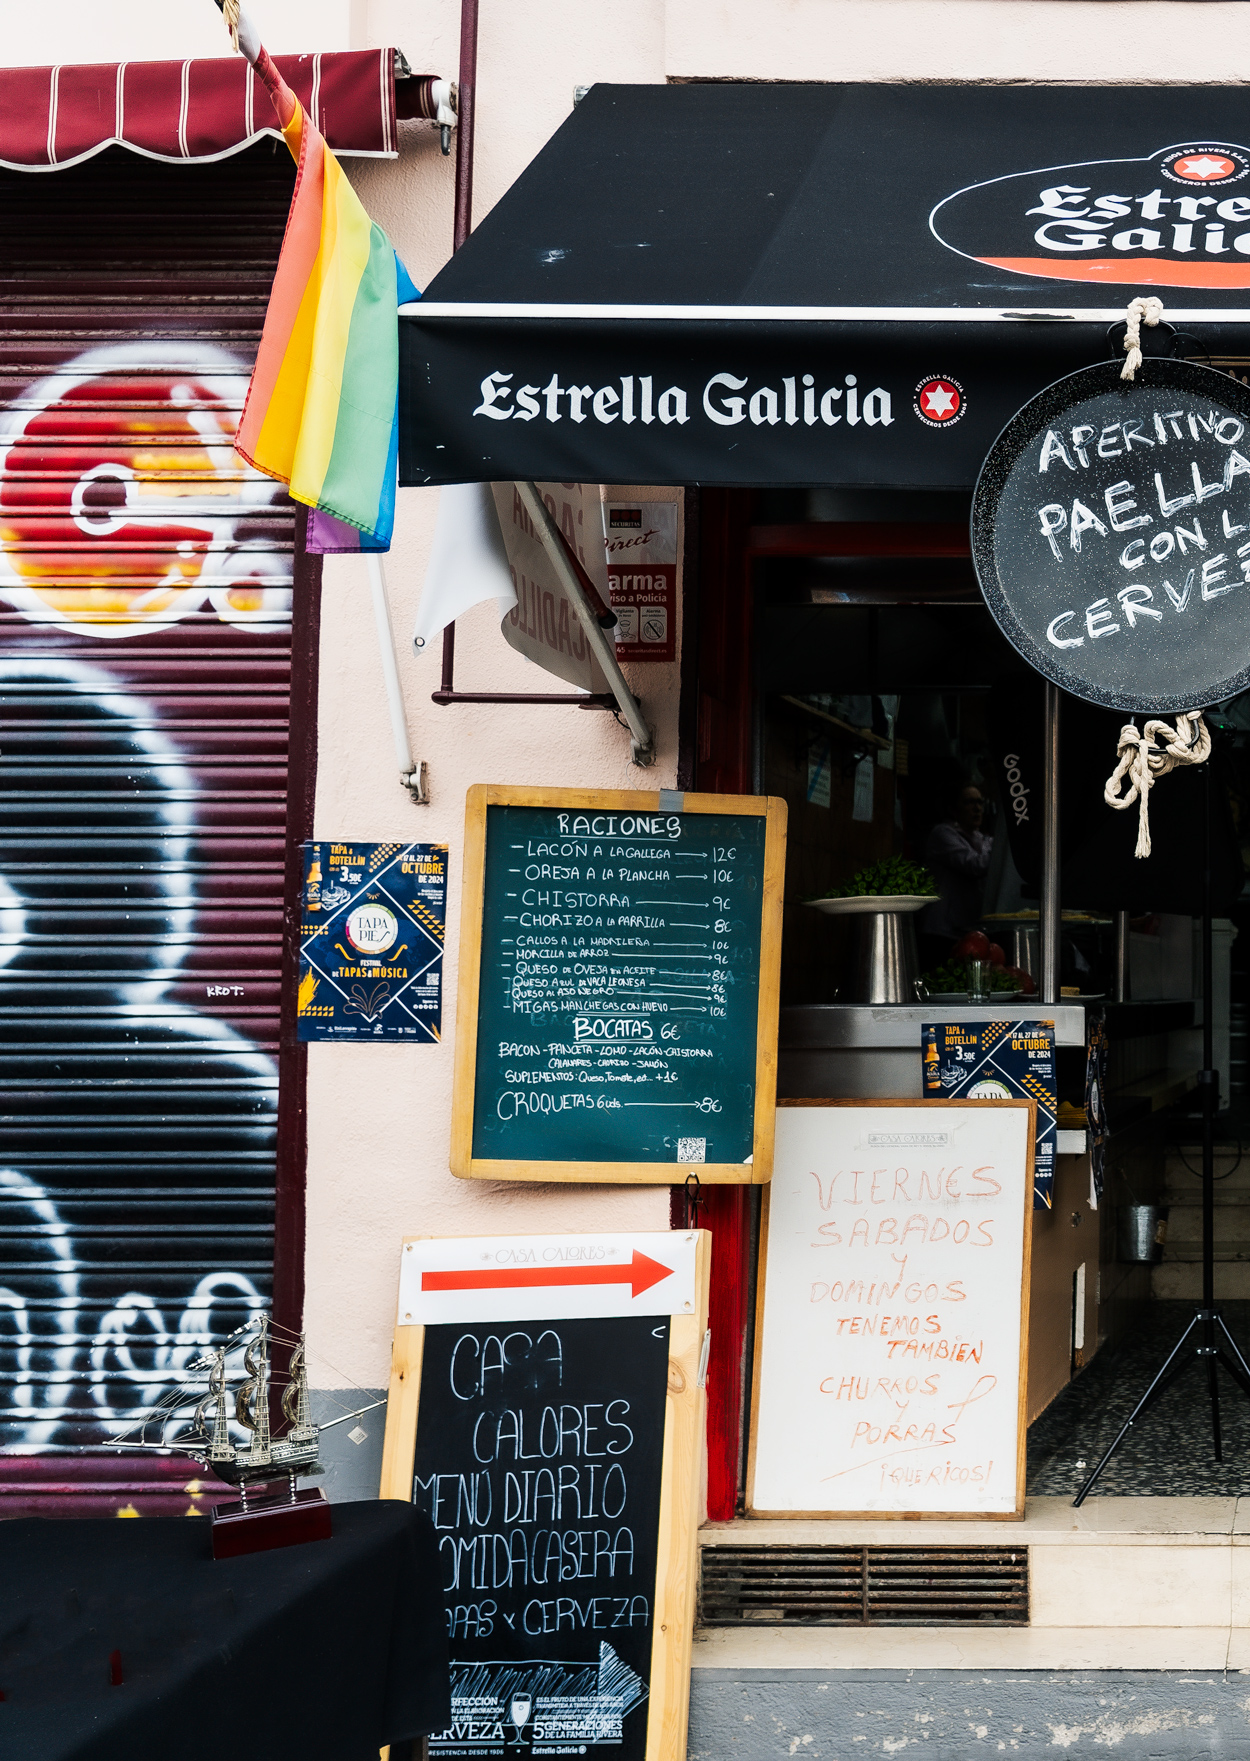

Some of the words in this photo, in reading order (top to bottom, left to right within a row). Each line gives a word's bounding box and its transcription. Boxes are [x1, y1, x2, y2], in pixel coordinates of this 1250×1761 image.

[915, 374, 941, 392] ESTRELLA
[942, 374, 964, 393] GALICIA
[472, 370, 690, 425] Estrella
[702, 372, 895, 426] Galicia
[1038, 410, 1245, 473] APERITIVO
[1119, 517, 1208, 571] CON
[637, 592, 667, 603] Policía
[557, 813, 682, 838] RACIONES
[329, 855, 366, 868] BOTELLÍN
[330, 845, 347, 855] TAPA
[528, 840, 587, 857] LACÓN
[593, 845, 603, 857] A
[625, 848, 671, 860] GALLEGA
[713, 847, 737, 863] 12€
[401, 862, 444, 875] OCTUBRE
[418, 875, 427, 883] DE
[427, 875, 444, 884] 2024
[525, 864, 580, 881] OREJA
[586, 868, 596, 880] A
[602, 869, 614, 880] LA
[619, 868, 670, 881] PLANCHA
[713, 870, 734, 883] 10€
[522, 889, 630, 908] CHISTORRA
[712, 896, 731, 911] 9€
[356, 917, 389, 929] TAPA
[520, 912, 594, 927] CHORIZO
[595, 917, 602, 927] A
[618, 915, 665, 928] PARRILLA
[714, 919, 732, 933] 8€
[339, 967, 367, 978] TAPAS
[371, 965, 408, 978] MÚSICA
[513, 1001, 559, 1013] MIGAS
[574, 1018, 653, 1040] BOCATAS
[660, 1023, 681, 1040] 6€
[497, 1091, 595, 1120] CROQUETAS
[700, 1097, 723, 1112] 8€
[809, 1165, 1002, 1211] VIERNES
[495, 1248, 537, 1264] CASA
[542, 1245, 606, 1262] CALORES
[810, 1279, 967, 1306] DOMINGOS
[836, 1313, 942, 1336] TENEMOS
[819, 1373, 941, 1401] CHURROS
[473, 1399, 634, 1463] CALORES
[851, 1421, 956, 1449] PORRAS
[504, 1463, 627, 1523] DIARIO
[439, 1529, 528, 1591] OMIDA
[531, 1527, 634, 1584] CASERA
[523, 1594, 650, 1635] CERVEZA
